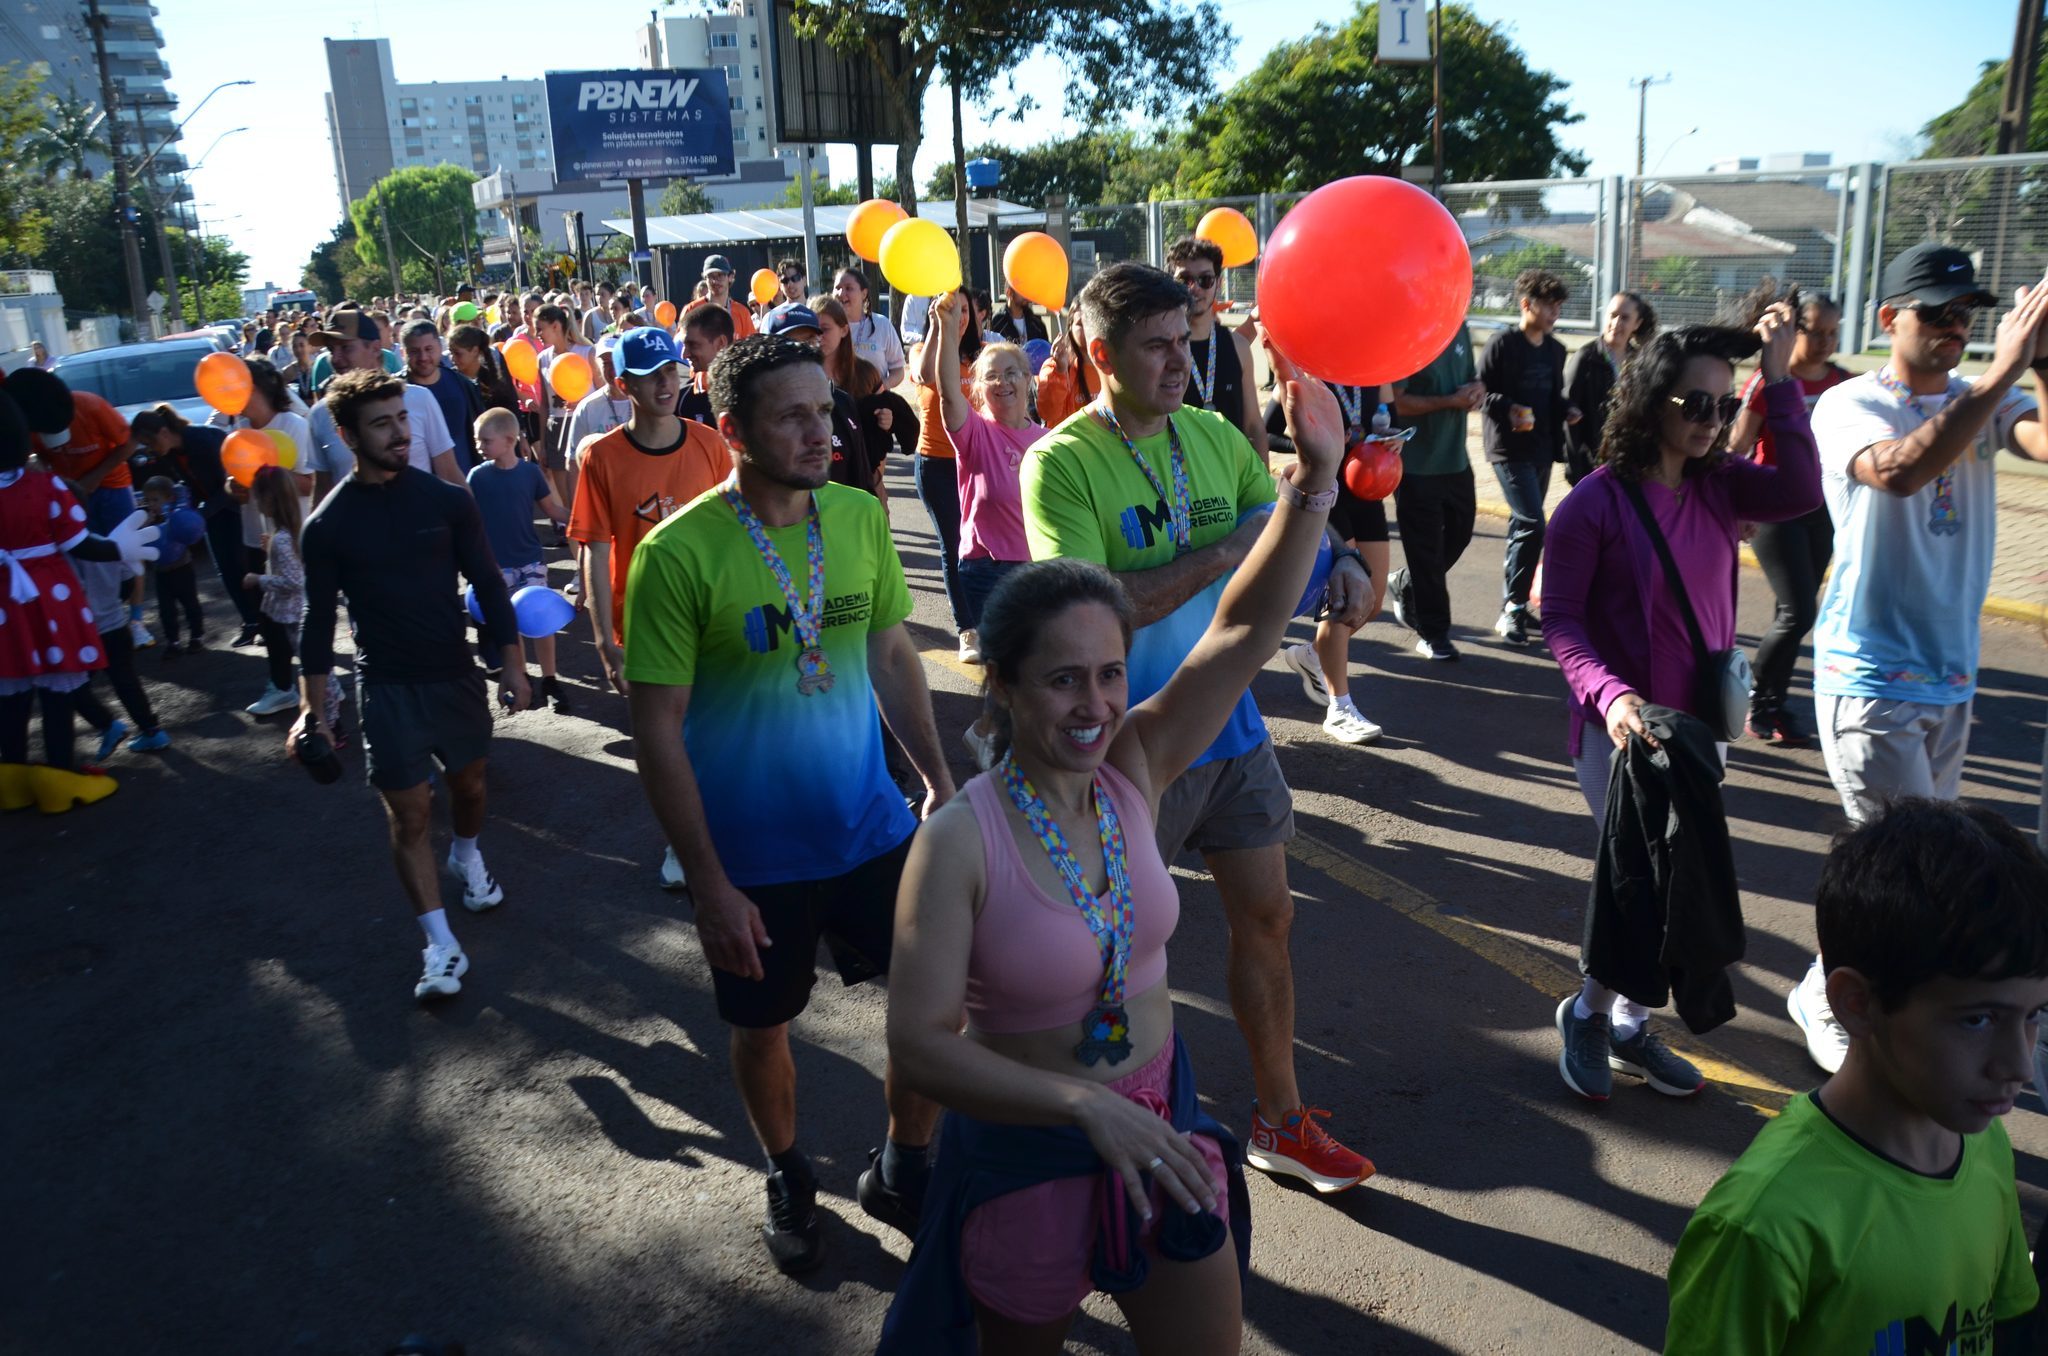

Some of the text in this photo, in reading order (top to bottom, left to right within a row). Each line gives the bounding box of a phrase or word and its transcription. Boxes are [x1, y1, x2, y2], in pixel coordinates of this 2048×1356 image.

[578, 78, 700, 111] PBNEW
[609, 109, 702, 123] SISTEMAS
[602, 129, 683, 142] Soluções tecnológicas
[603, 140, 615, 148] em
[616, 139, 648, 149] produtos
[639, 333, 669, 351] LA
[1189, 496, 1230, 512] DEMIA
[1190, 511, 1234, 529] RENCIO
[824, 591, 870, 611] ADEMIA
[1961, 1298, 1994, 1328] ACA
